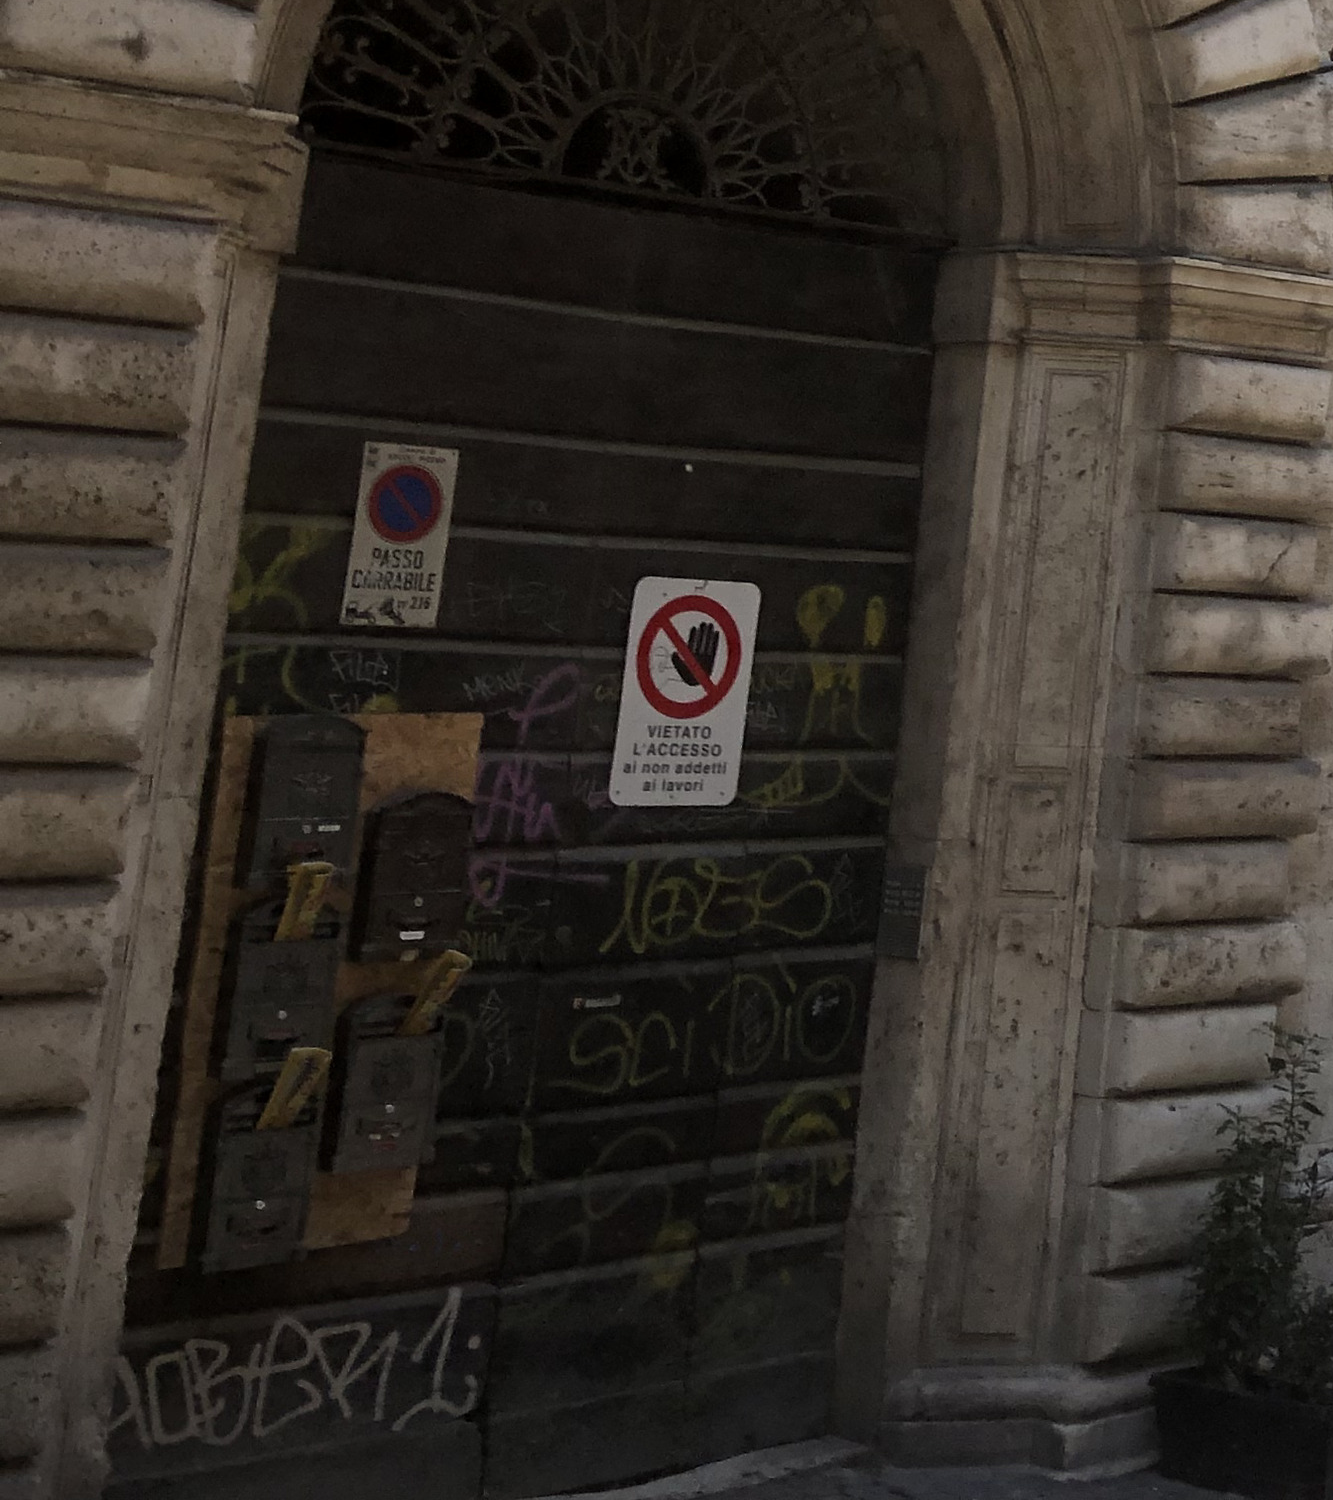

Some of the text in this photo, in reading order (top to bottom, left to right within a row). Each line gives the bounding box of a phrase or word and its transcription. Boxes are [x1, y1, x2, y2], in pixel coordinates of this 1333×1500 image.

[372, 547, 424, 570] PASSO
[351, 569, 437, 592] CARRABILE
[647, 725, 712, 739] VIETATO
[633, 743, 722, 757] L'ACCESSO
[623, 761, 727, 775] ai non addetti
[642, 779, 704, 792] ai lavori
